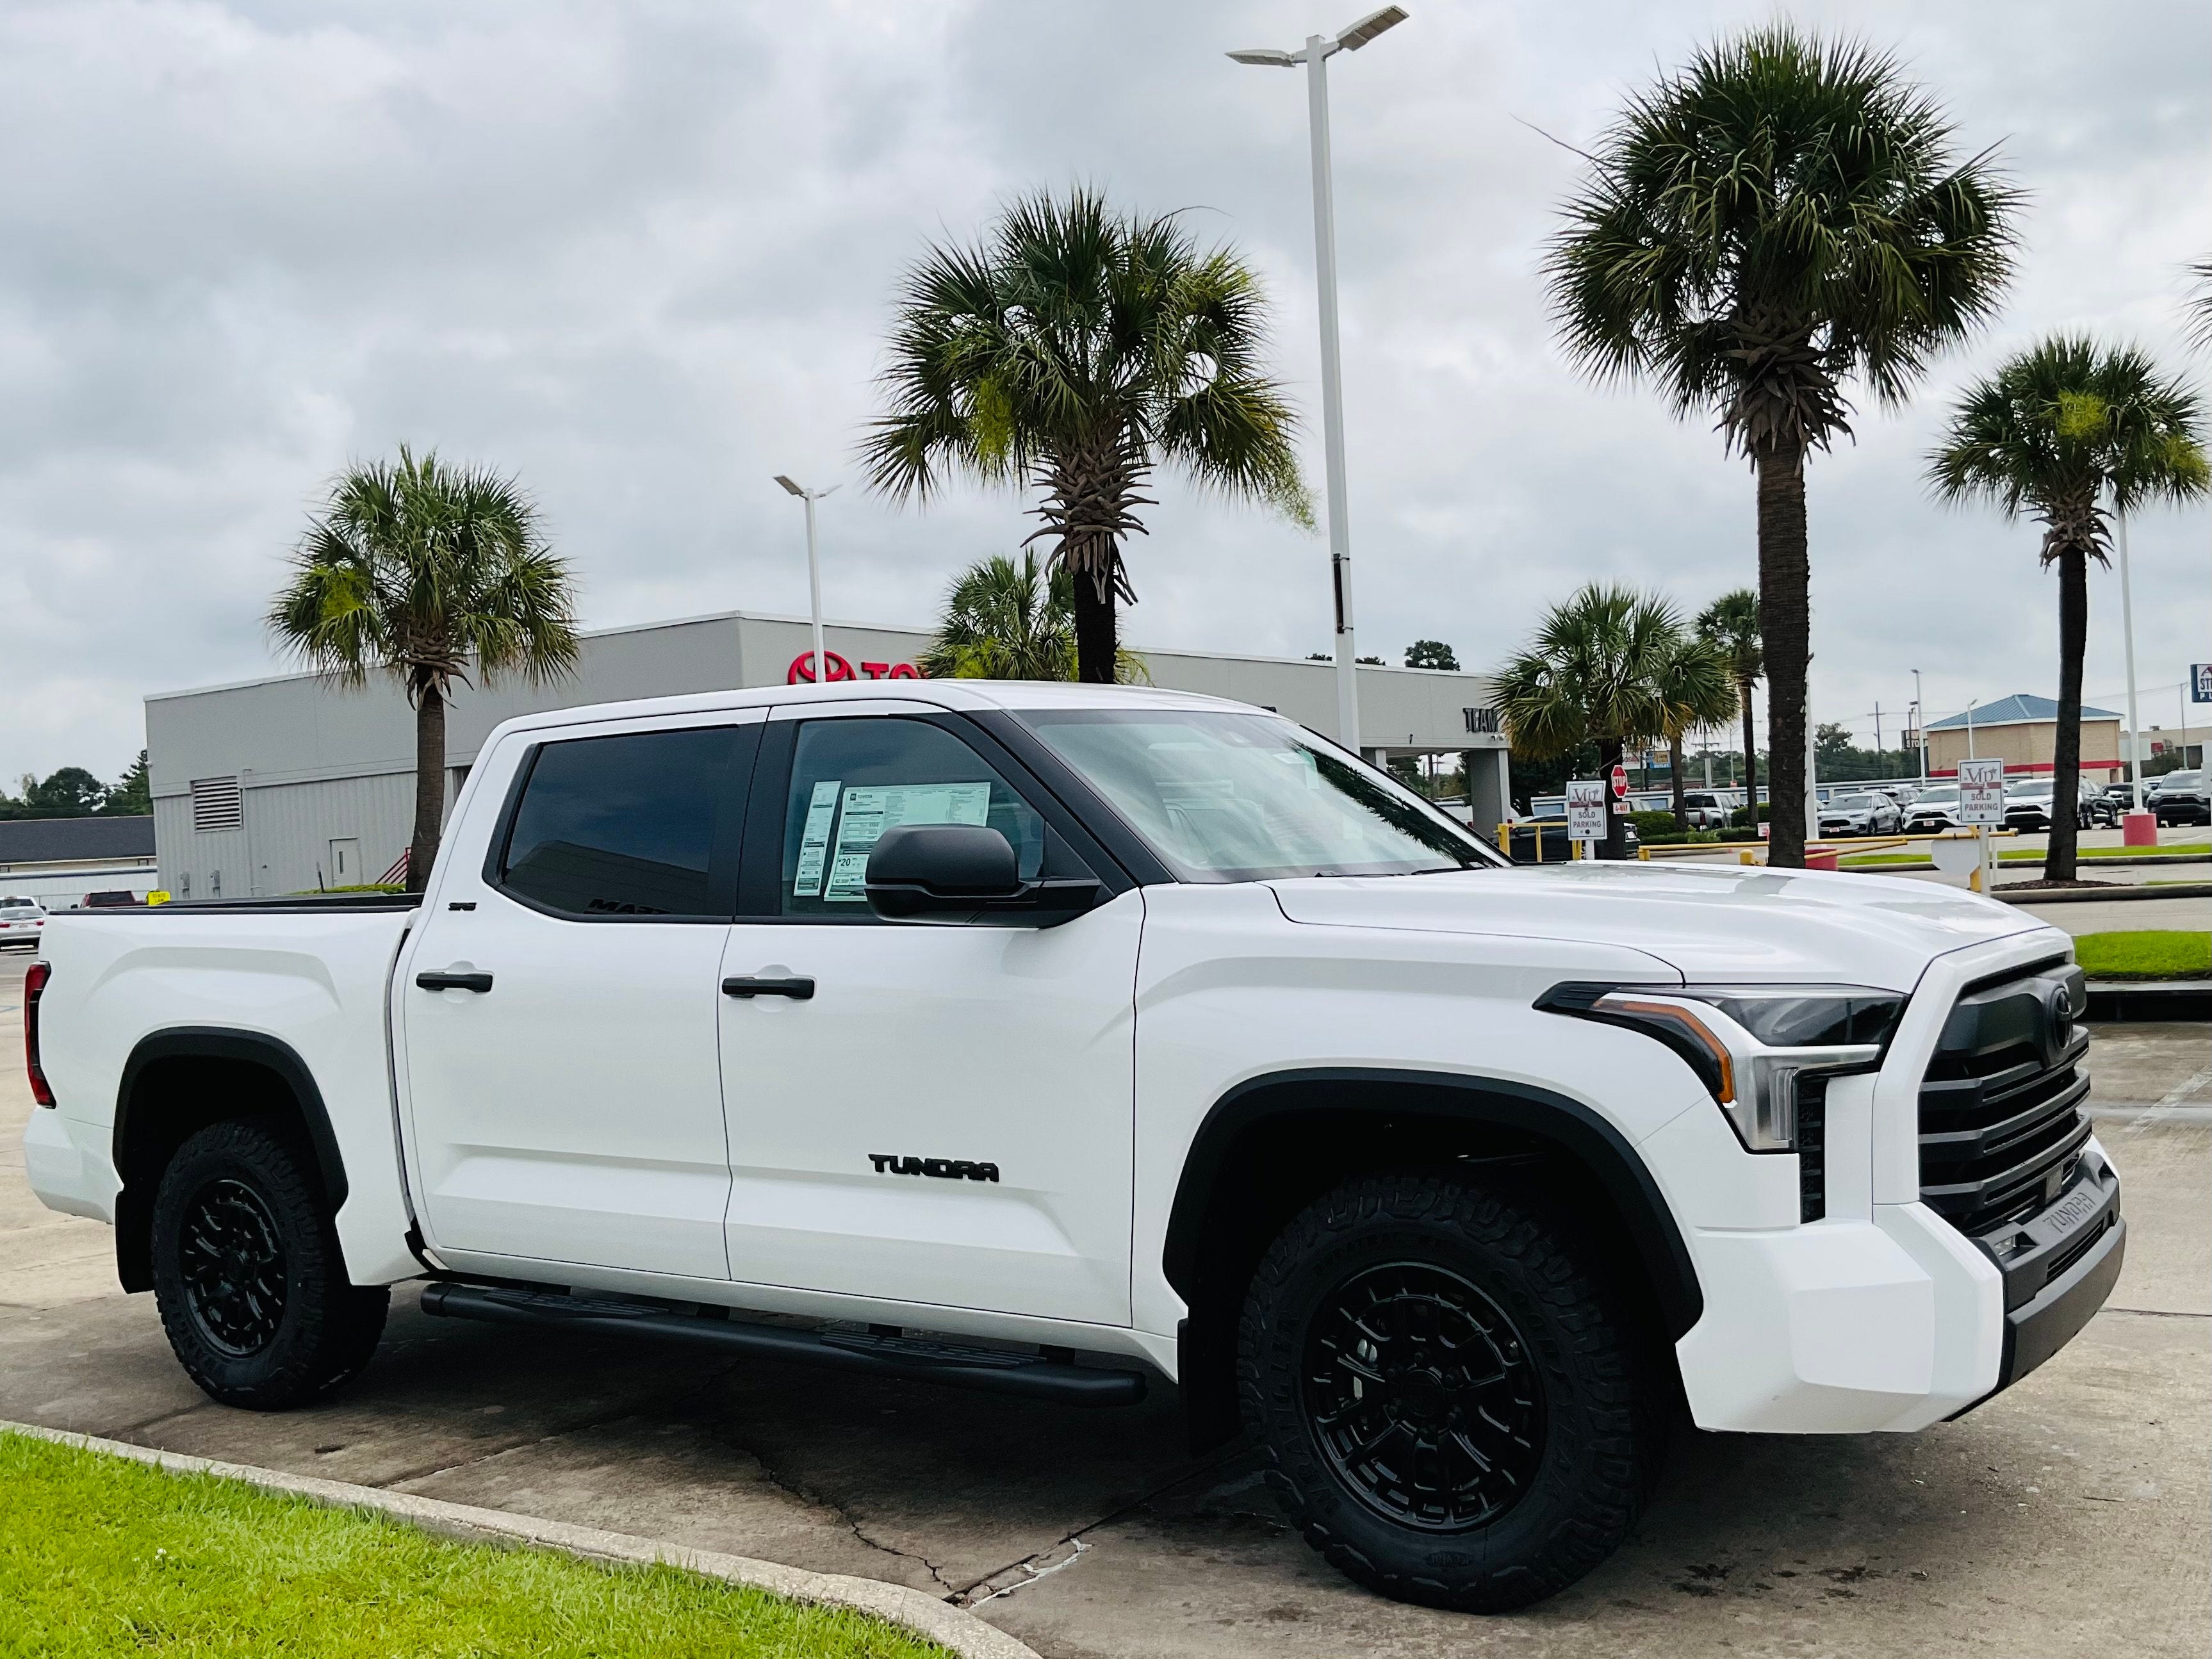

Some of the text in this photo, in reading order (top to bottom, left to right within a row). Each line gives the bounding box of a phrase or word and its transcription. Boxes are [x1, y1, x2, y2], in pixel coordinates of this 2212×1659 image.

[1462, 708, 1498, 733] TEAM
[1612, 776, 1626, 787] STOP
[868, 1154, 999, 1182] TUNDRA
[2042, 1192, 2097, 1234] TUNDRA
